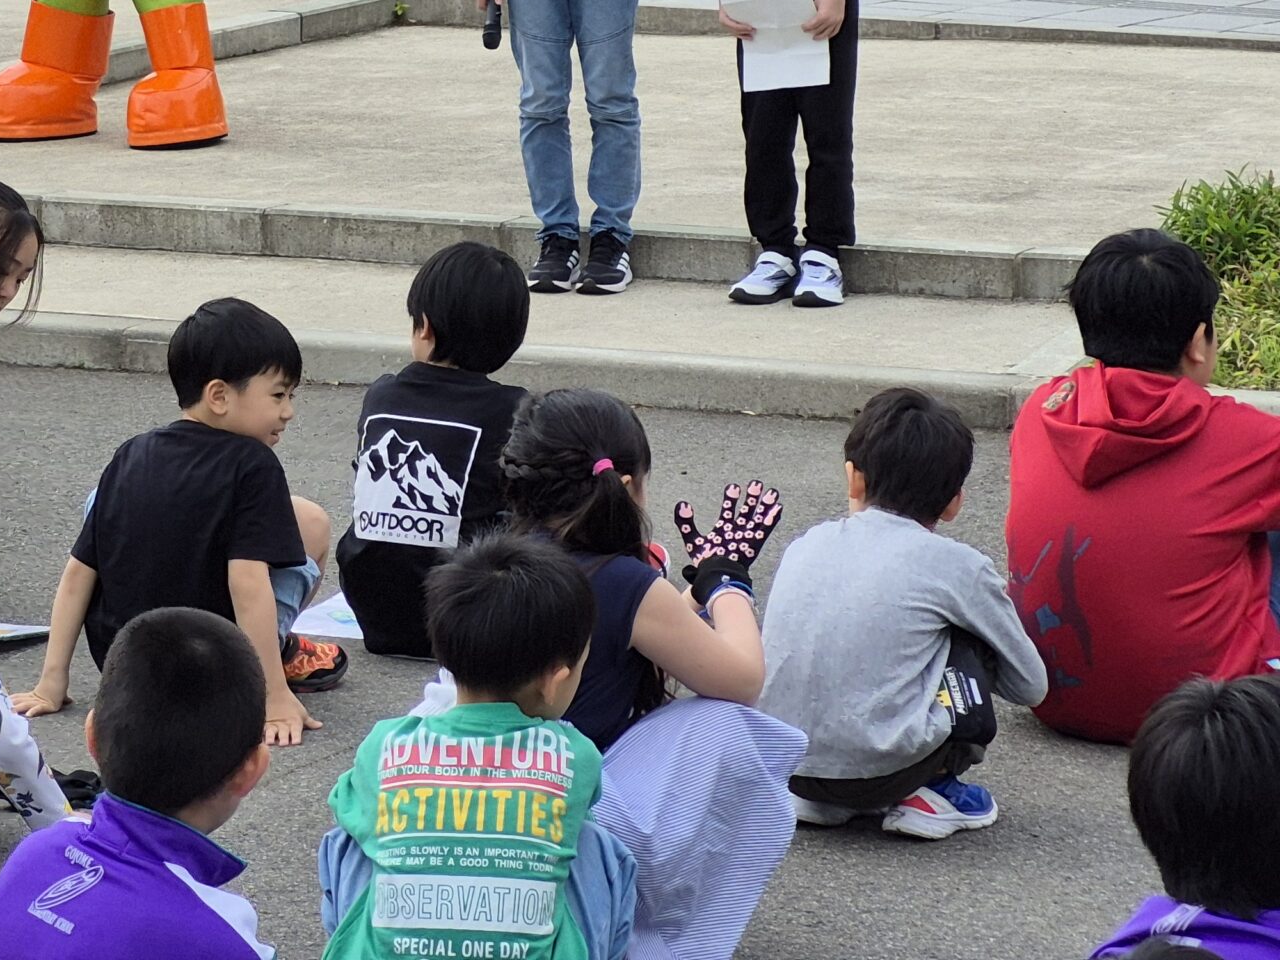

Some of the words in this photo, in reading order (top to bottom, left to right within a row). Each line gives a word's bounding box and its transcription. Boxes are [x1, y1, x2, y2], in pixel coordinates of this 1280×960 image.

[360, 511, 444, 542] OUTDOOR
[379, 727, 575, 778] ADVENTURE
[401, 765, 429, 775] YOUR
[435, 766, 465, 776] BODY
[470, 767, 480, 776] IN
[487, 768, 506, 778] THE
[512, 769, 573, 788] WILDERNESS
[375, 787, 567, 843] ACTIVITIES
[406, 857, 429, 866] MAY
[430, 857, 442, 866] BE
[448, 857, 455, 866] A
[460, 858, 488, 867] GOOD
[495, 859, 523, 870] THING
[410, 846, 449, 856] SLOWLY
[454, 847, 463, 856] IS
[466, 848, 480, 856] AN
[484, 848, 539, 860] IMPORTANT
[377, 882, 554, 927] OBSERVATION
[393, 937, 456, 957] SPECIAL
[462, 940, 493, 959] ONE
[500, 941, 530, 959] DAY
